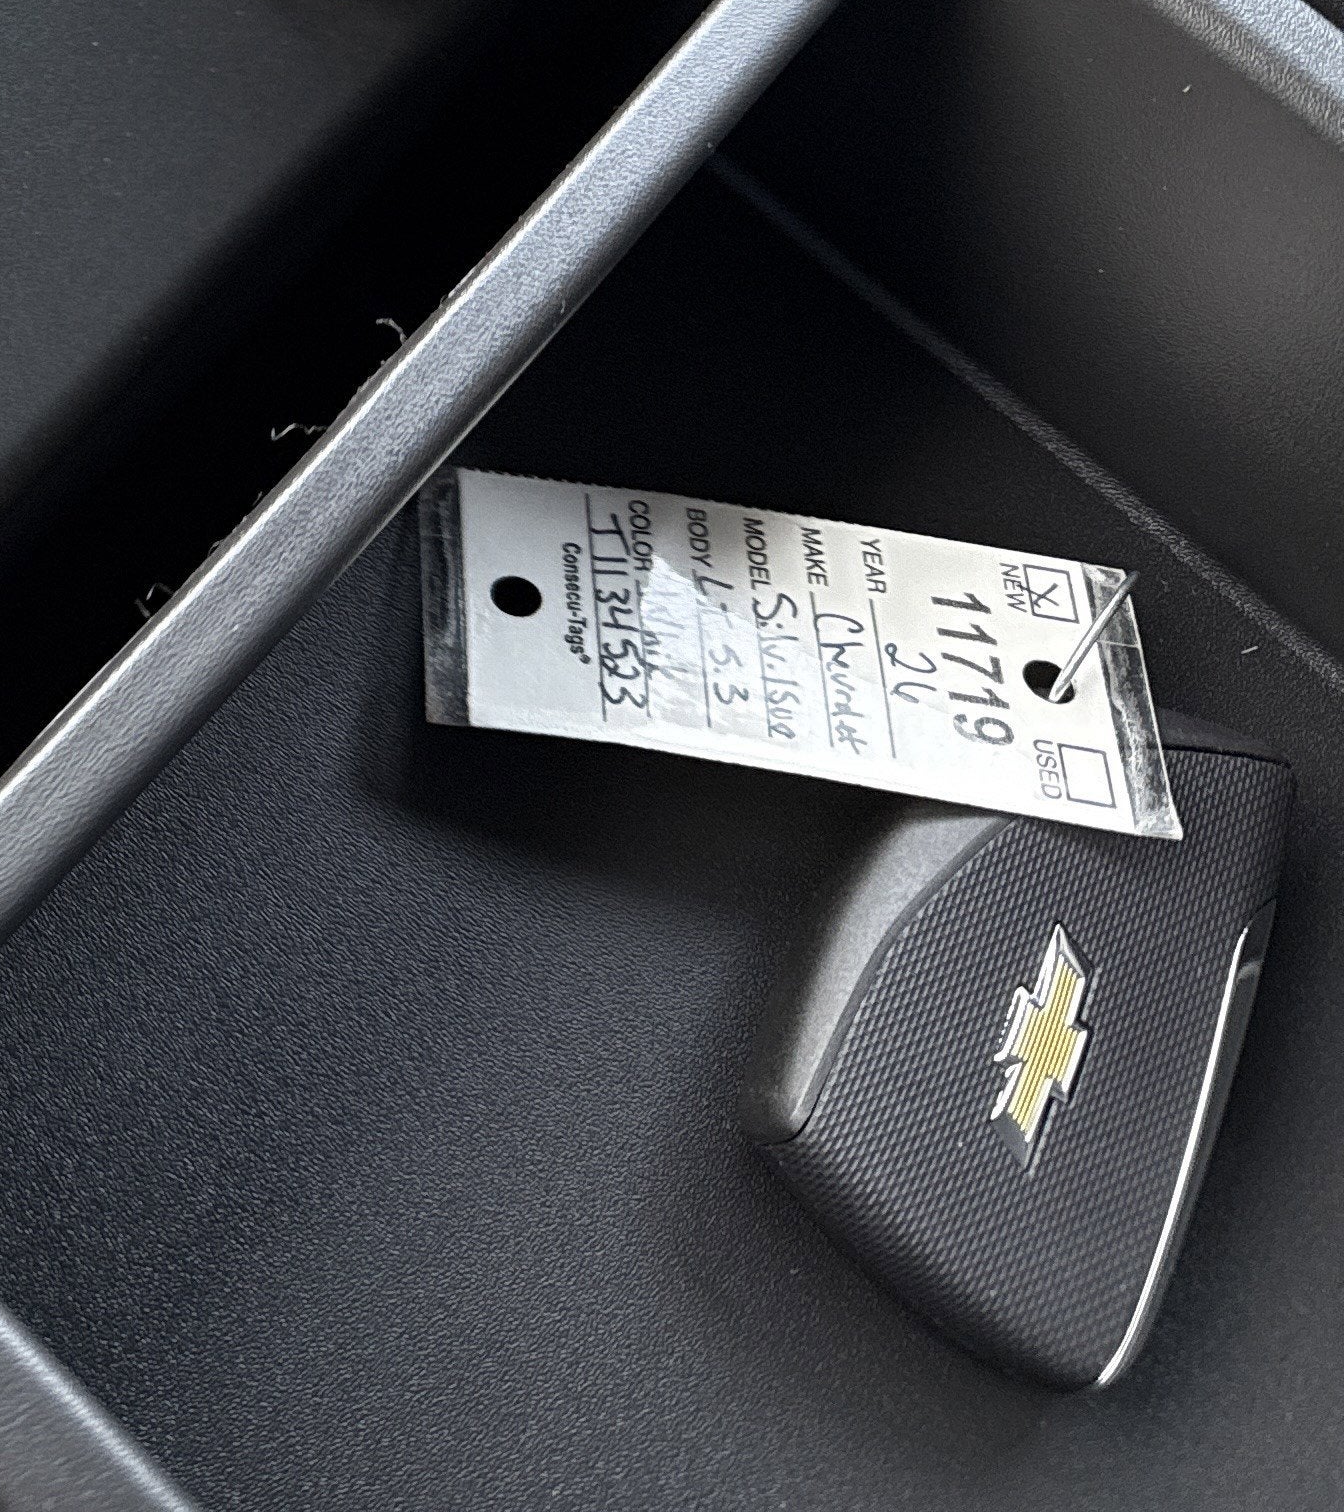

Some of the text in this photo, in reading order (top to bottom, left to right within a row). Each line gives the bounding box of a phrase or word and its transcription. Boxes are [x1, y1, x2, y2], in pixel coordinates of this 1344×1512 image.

[628, 500, 654, 571] COLOR
[742, 517, 771, 590] MODEL
[800, 526, 829, 587] MAKE
[686, 507, 713, 568] BODY
[708, 644, 749, 705] 5.3
[860, 538, 937, 704] YEAR 26
[999, 562, 1027, 613] NEW
[930, 592, 1015, 746] 11719
[1033, 739, 1063, 800] USED
